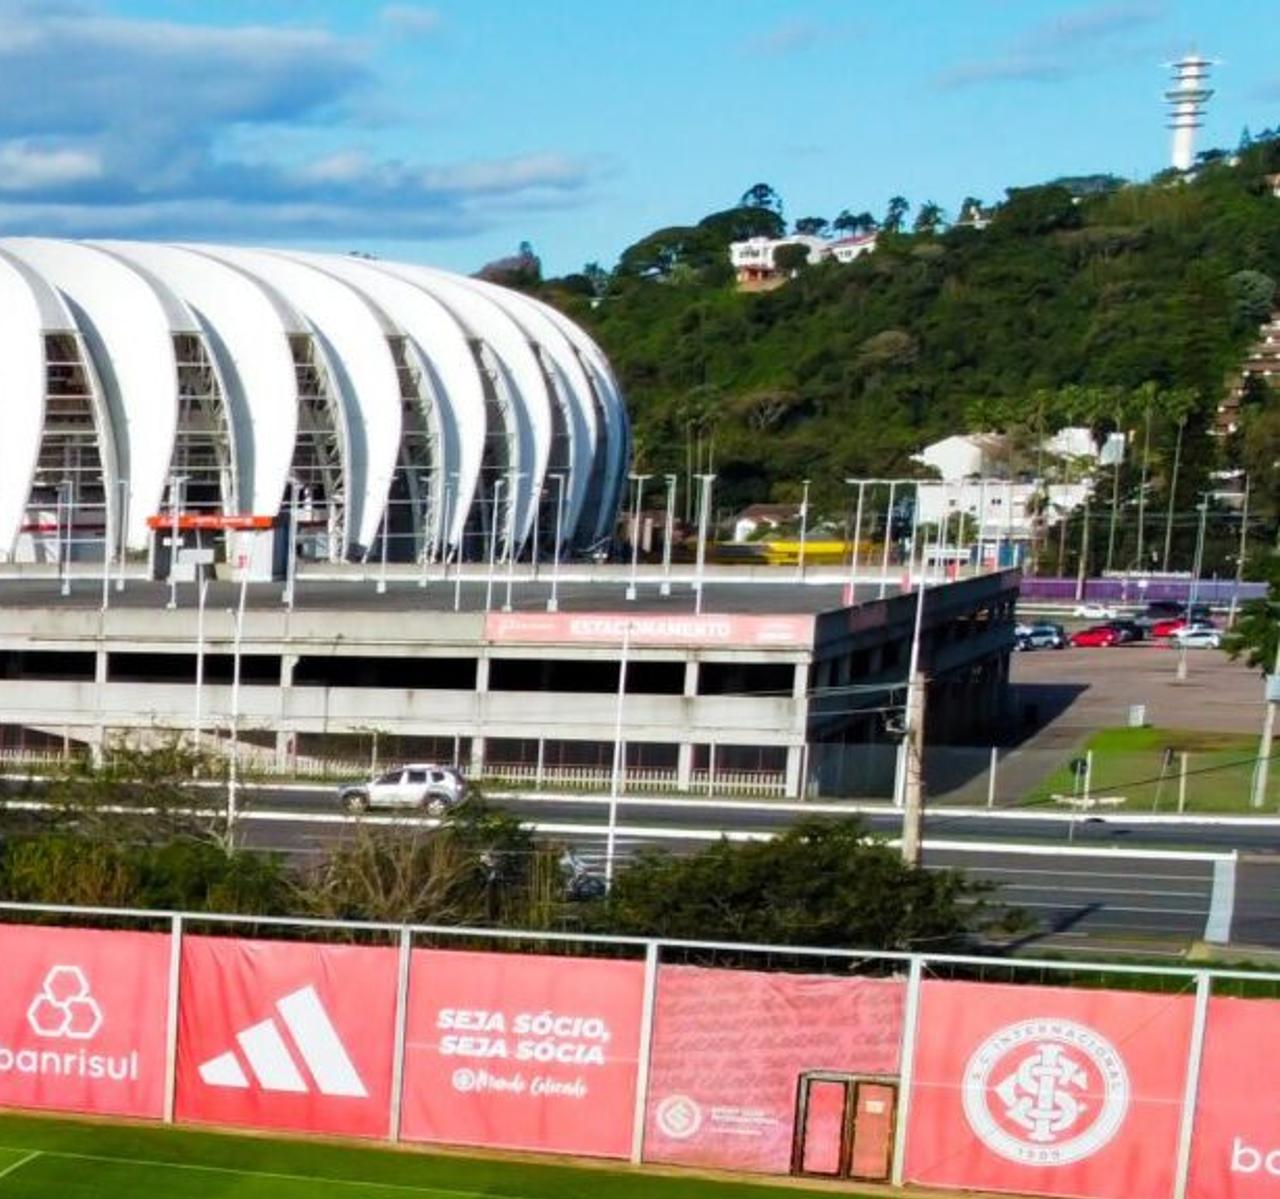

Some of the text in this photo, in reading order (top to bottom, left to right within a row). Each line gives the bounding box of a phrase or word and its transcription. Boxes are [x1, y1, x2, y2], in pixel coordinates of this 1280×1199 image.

[437, 1008, 610, 1042] SEJA SÓCIO,
[439, 1034, 605, 1066] SEJA SÓCIA
